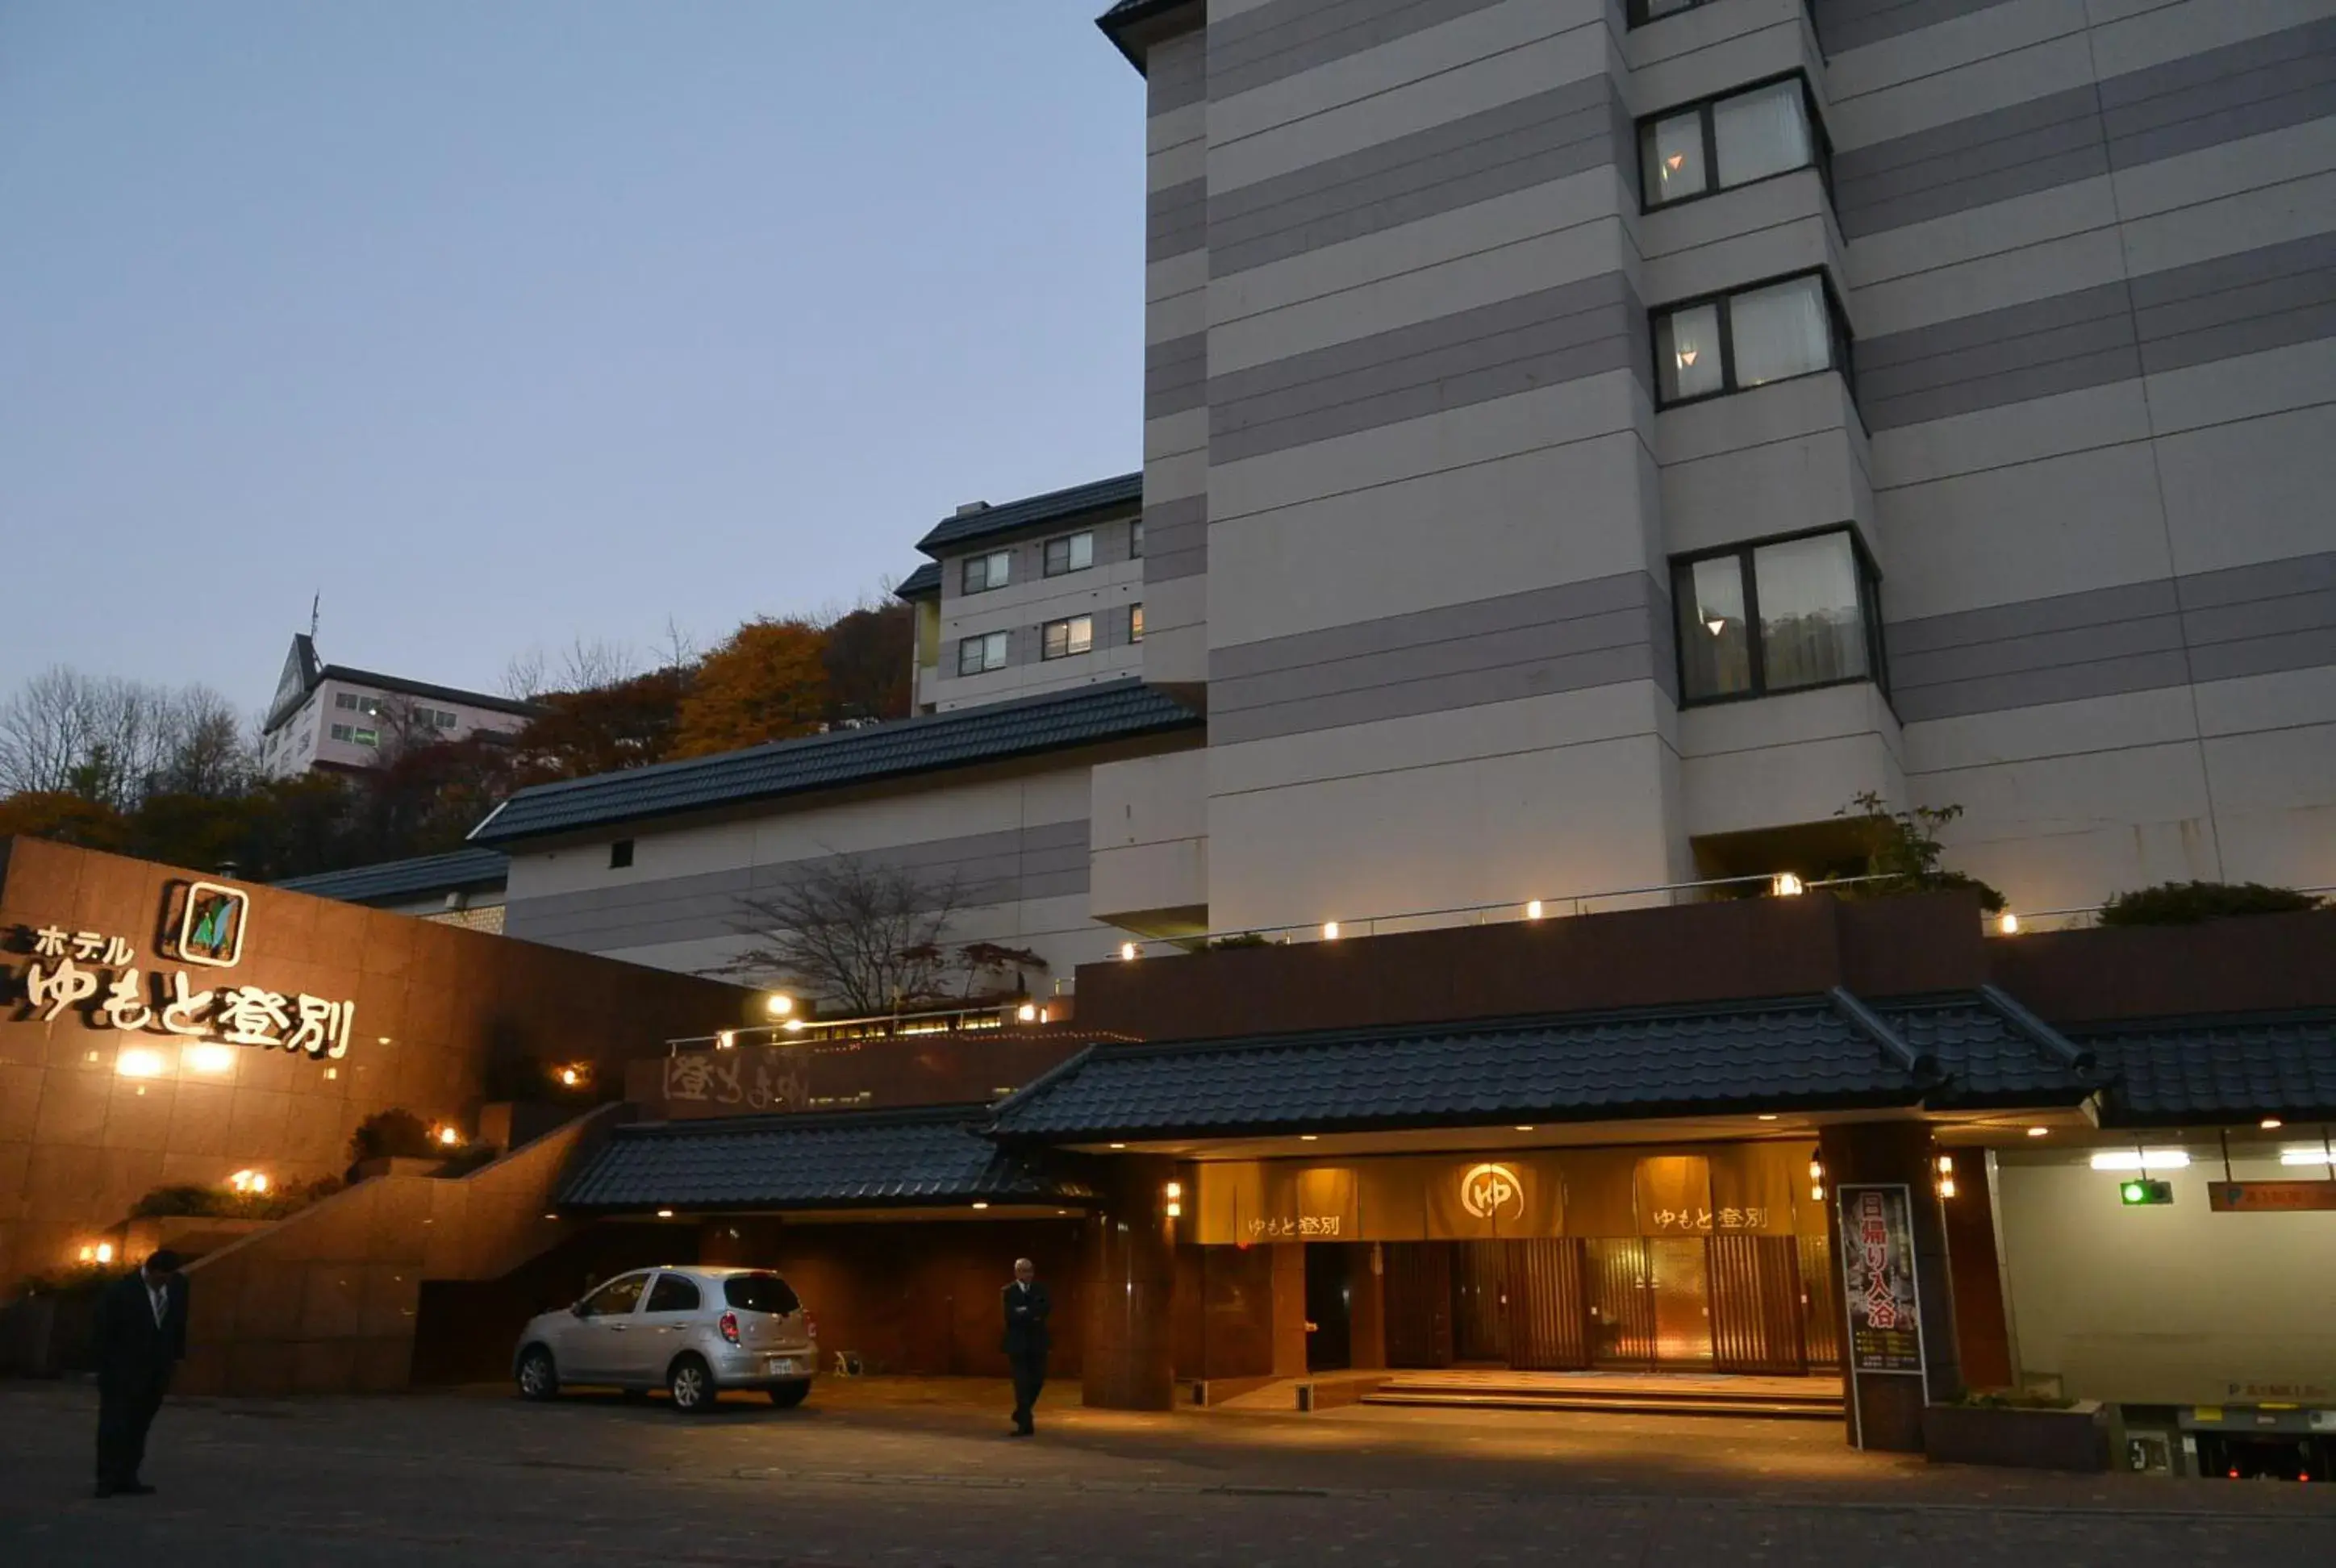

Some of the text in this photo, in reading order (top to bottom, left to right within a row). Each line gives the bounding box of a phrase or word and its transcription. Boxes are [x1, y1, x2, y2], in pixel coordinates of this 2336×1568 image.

[34, 925, 135, 967] ホテル
[27, 958, 354, 1059] ゆもと登別
[1245, 1216, 1341, 1237] ゆもと登別
[1653, 1207, 1768, 1231] ゆもと登別
[1860, 1193, 1895, 1328] 日帰り入浴
